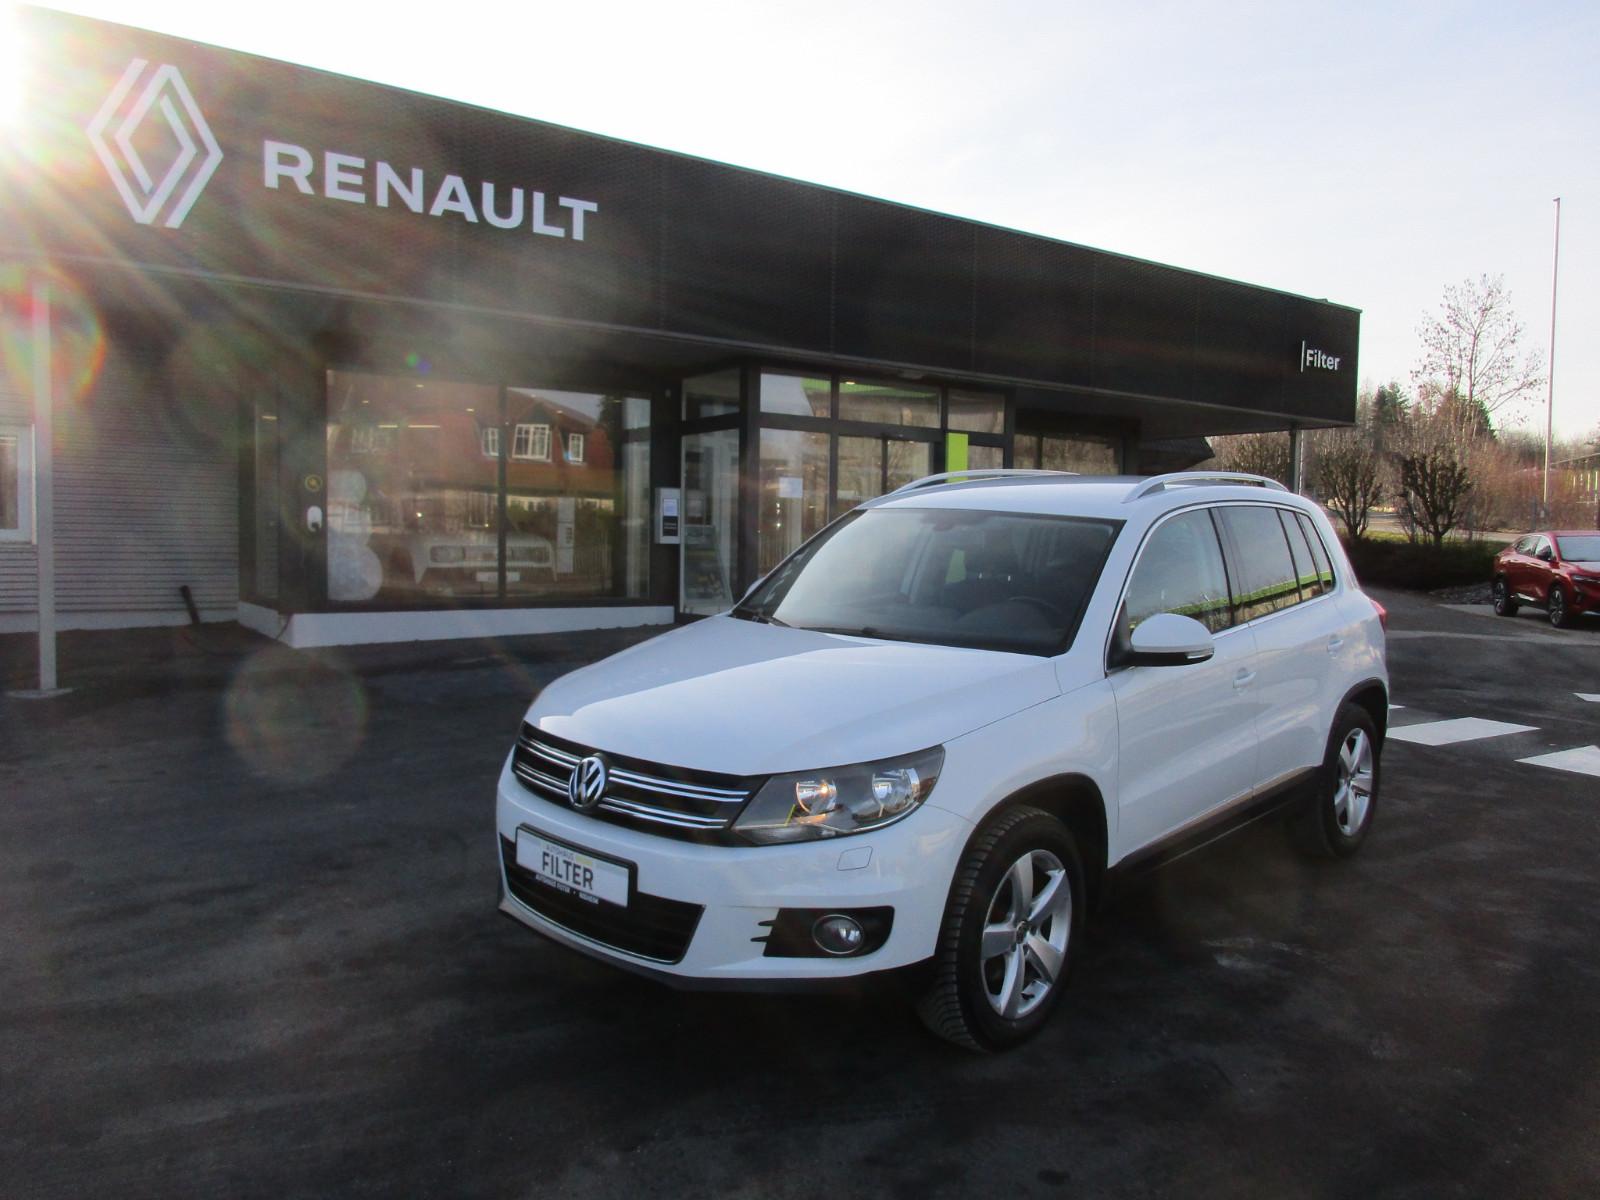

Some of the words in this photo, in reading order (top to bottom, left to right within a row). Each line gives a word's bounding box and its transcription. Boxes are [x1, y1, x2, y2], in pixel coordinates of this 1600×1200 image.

[263, 140, 598, 241] RENAULT
[1306, 349, 1340, 371] Filter
[541, 850, 594, 890] FILTER
